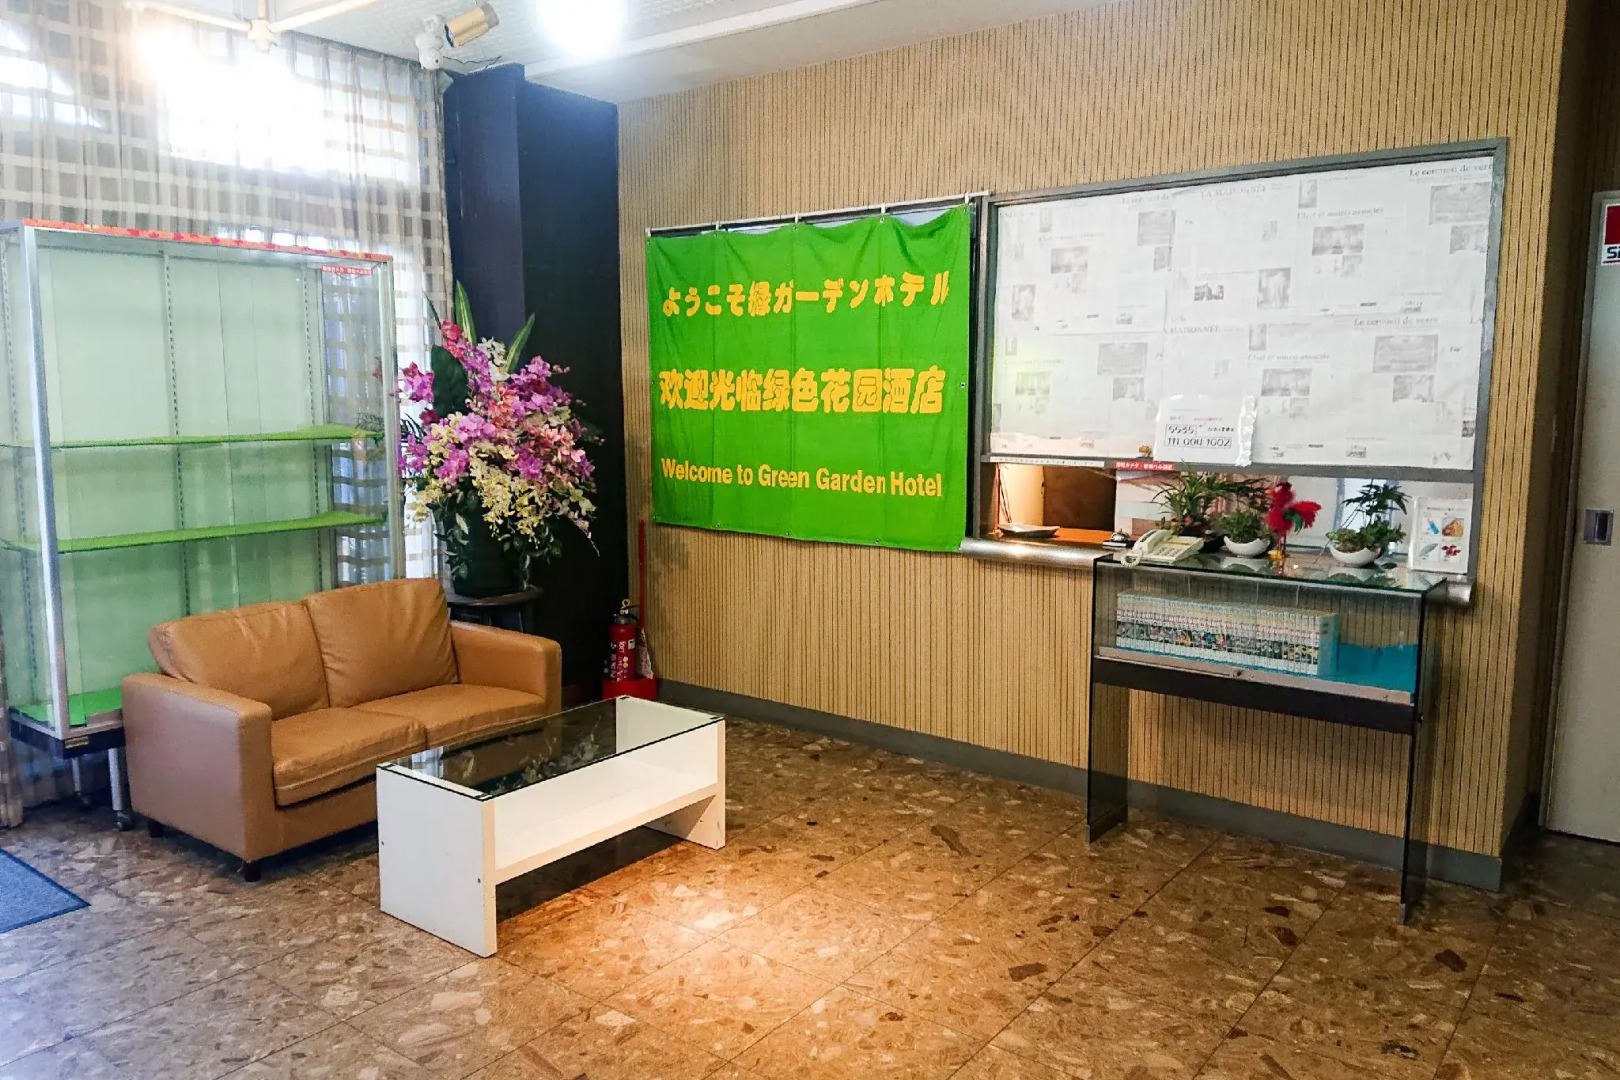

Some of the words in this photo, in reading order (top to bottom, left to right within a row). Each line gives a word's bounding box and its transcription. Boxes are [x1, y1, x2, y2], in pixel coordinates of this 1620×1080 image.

[1606, 245, 1620, 259] S
[662, 271, 950, 317] ようこそ緑ガーデンホテル
[658, 364, 946, 414] 欢迎光临绿色花园酒店
[661, 458, 733, 483] Welcome
[736, 464, 754, 485] to
[758, 464, 810, 488] Green
[815, 468, 886, 494] Garden
[890, 471, 942, 496] Hotel
